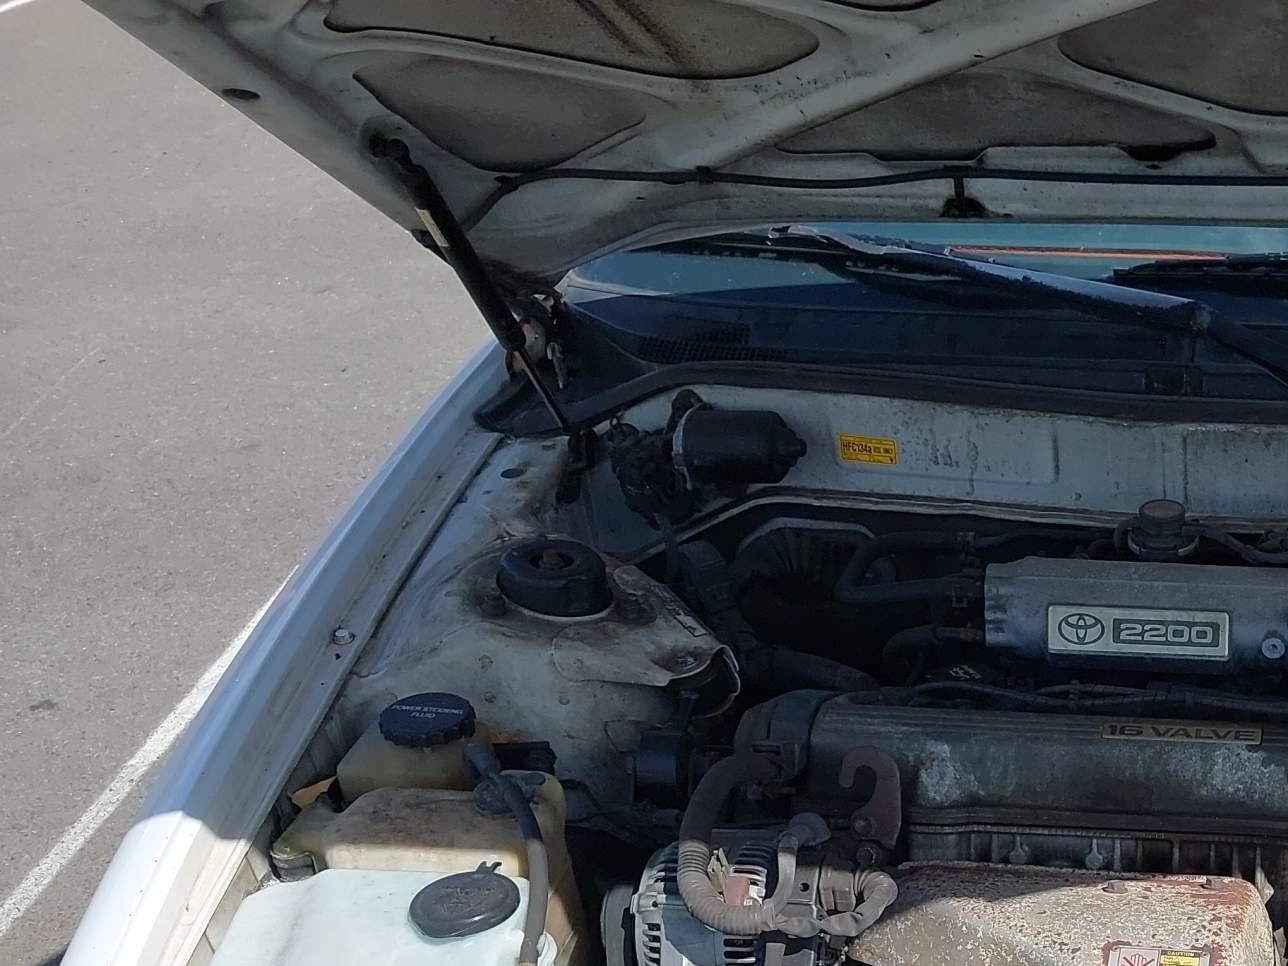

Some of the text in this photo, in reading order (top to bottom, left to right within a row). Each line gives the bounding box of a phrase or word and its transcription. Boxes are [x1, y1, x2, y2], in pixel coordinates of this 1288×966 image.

[1119, 623, 1213, 644] 2200
[1108, 724, 1257, 741] 16 VALVE
